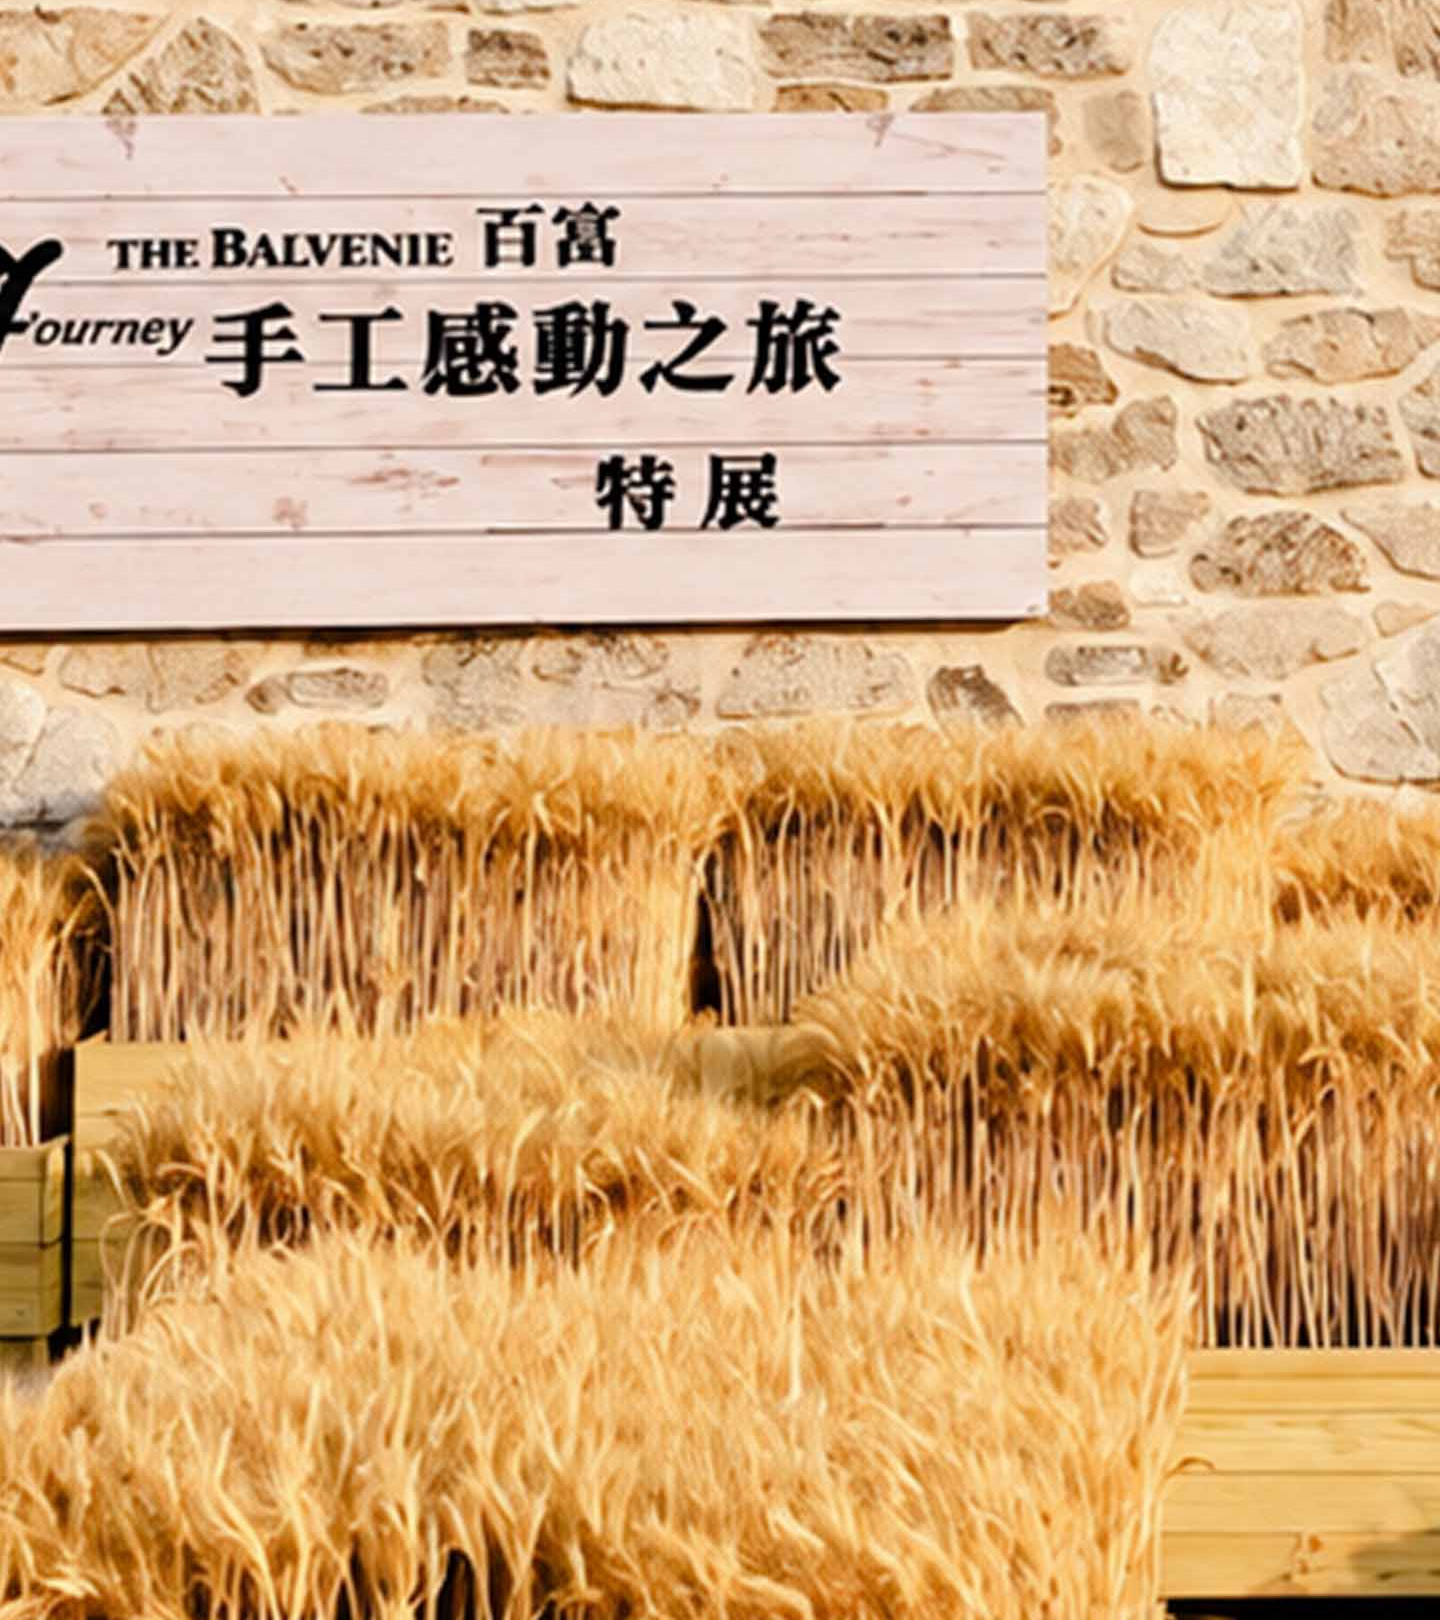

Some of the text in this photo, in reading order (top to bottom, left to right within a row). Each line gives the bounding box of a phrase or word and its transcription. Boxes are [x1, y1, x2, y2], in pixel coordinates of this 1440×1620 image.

[106, 201, 621, 270] THE BALVENIE 百富
[204, 298, 842, 398] 手工感動之旅
[594, 452, 780, 531] 特展
